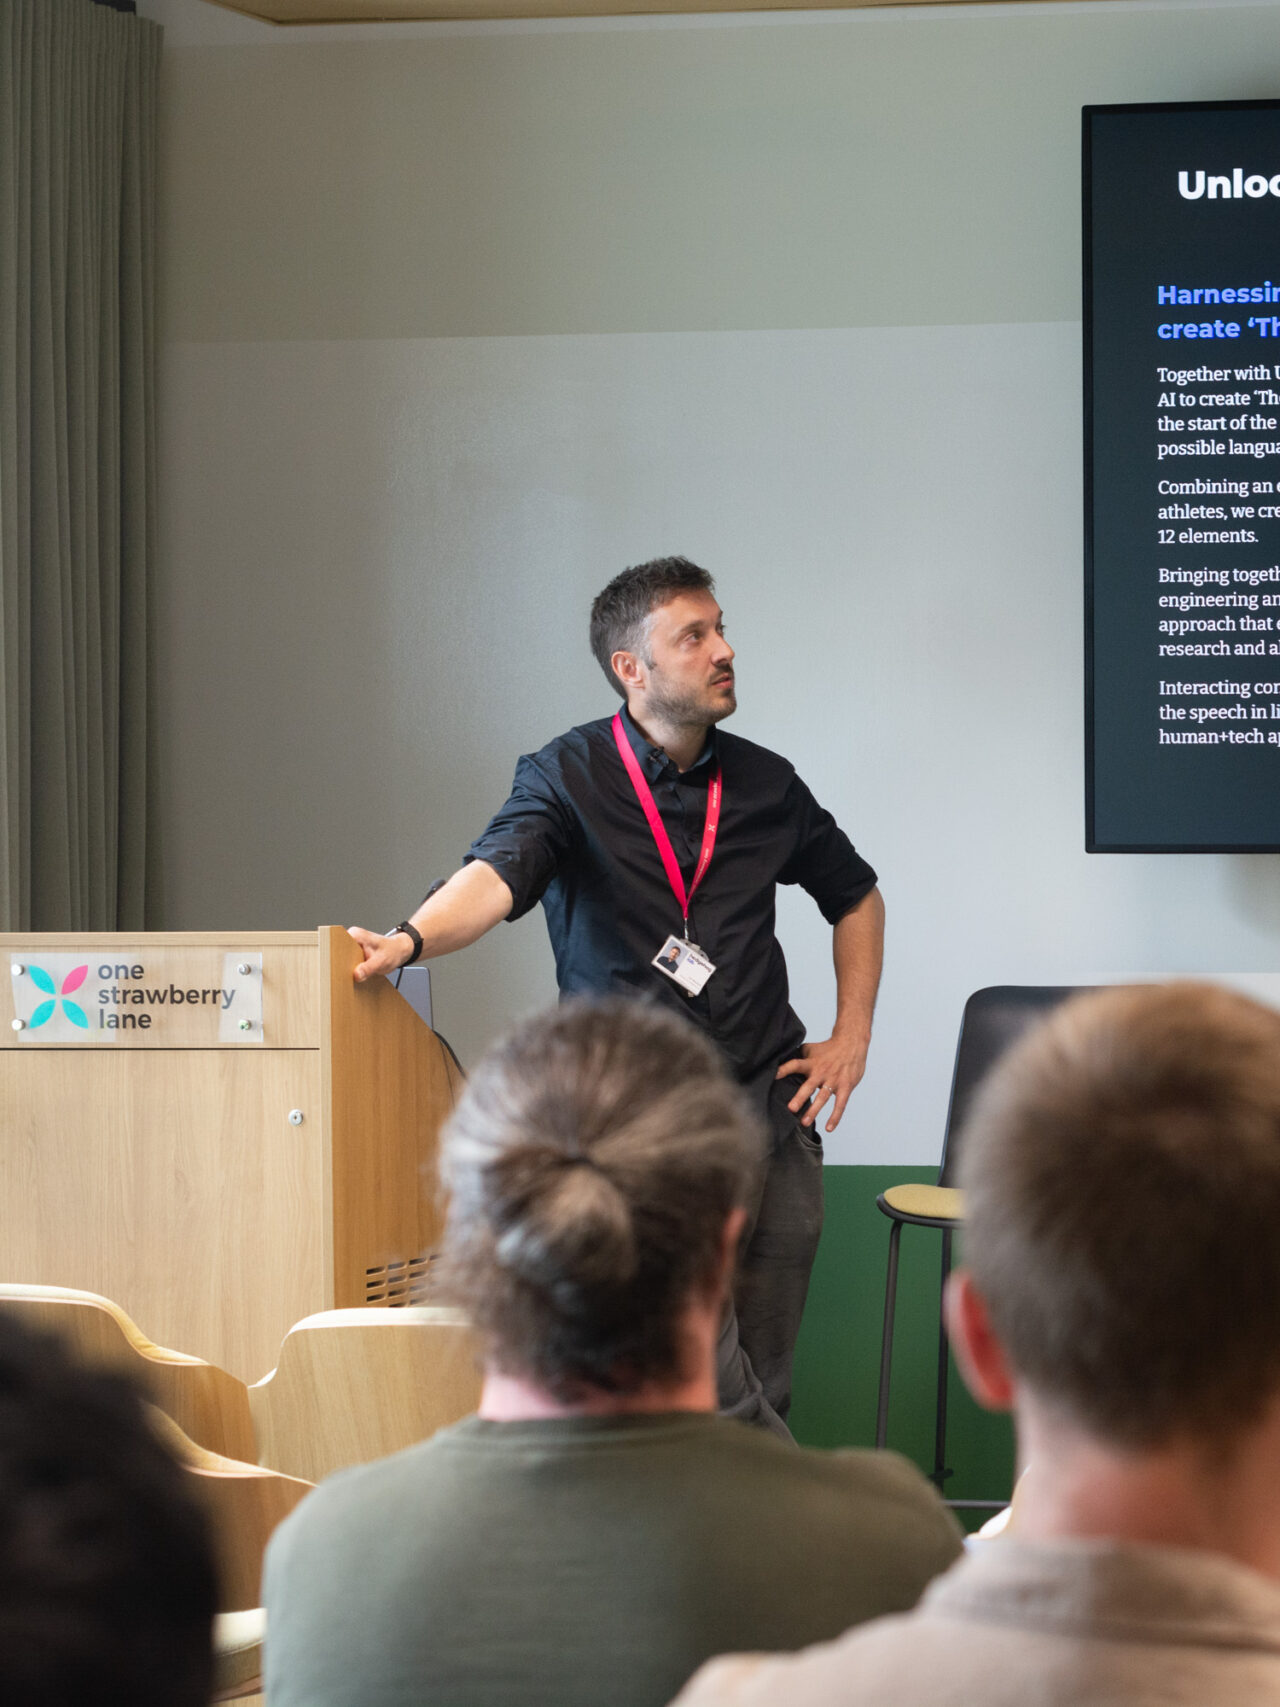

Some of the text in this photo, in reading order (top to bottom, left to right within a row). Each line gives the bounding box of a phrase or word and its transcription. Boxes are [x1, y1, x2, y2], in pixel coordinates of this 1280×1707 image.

[1157, 319, 1241, 339] create
[1157, 365, 1231, 386] Together
[1233, 364, 1271, 380] with
[1157, 392, 1176, 407] AI
[1179, 393, 1196, 406] to
[1199, 392, 1251, 406] create
[1157, 415, 1185, 431] the
[1187, 417, 1227, 430] start
[1229, 414, 1248, 430] of
[1249, 414, 1277, 429] the
[1157, 439, 1225, 459] possible
[1158, 478, 1249, 497] Combining
[1252, 481, 1273, 493] an
[1158, 503, 1228, 520] athletes,
[1230, 506, 1254, 518] we
[1158, 528, 1258, 543] 12 elements.
[1158, 567, 1230, 586] Bringing
[1158, 591, 1259, 611] engineering
[1158, 615, 1236, 636] approach
[1239, 615, 1273, 631] that
[1159, 640, 1231, 656] research
[1234, 639, 1265, 655] and
[1159, 679, 1251, 698] Interacting
[1159, 704, 1186, 720] the
[1189, 703, 1247, 723] speech
[1251, 704, 1267, 719] in
[1159, 728, 1264, 744] human+tech
[97, 964, 145, 980] one
[98, 984, 236, 1009] strawberry
[99, 1009, 152, 1029] lane
